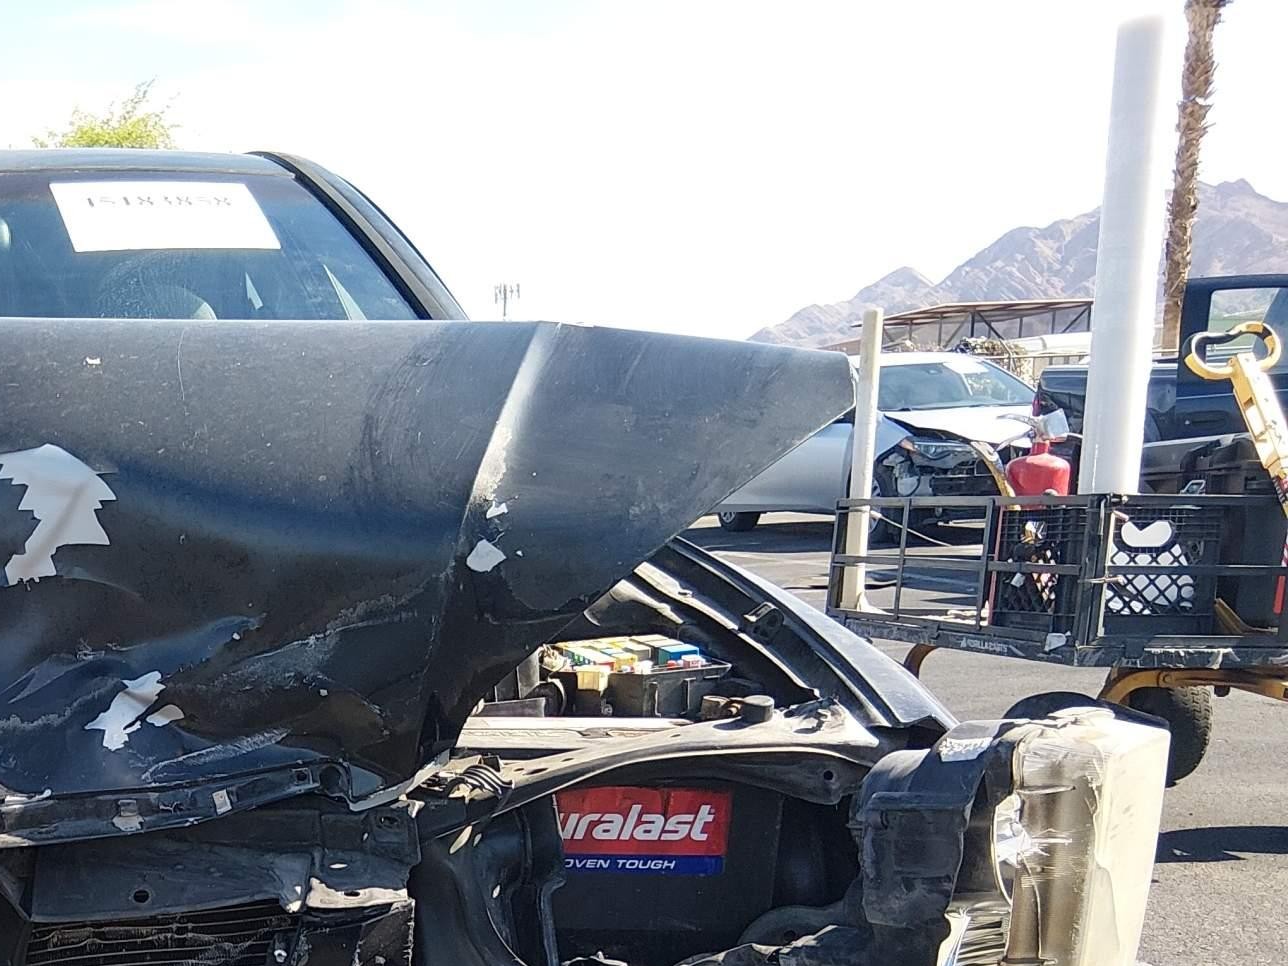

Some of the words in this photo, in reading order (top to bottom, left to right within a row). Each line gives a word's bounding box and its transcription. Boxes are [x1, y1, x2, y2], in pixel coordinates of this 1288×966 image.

[560, 804, 715, 841] uralast
[564, 858, 611, 869] OVEN
[616, 859, 676, 870] TOUGH
